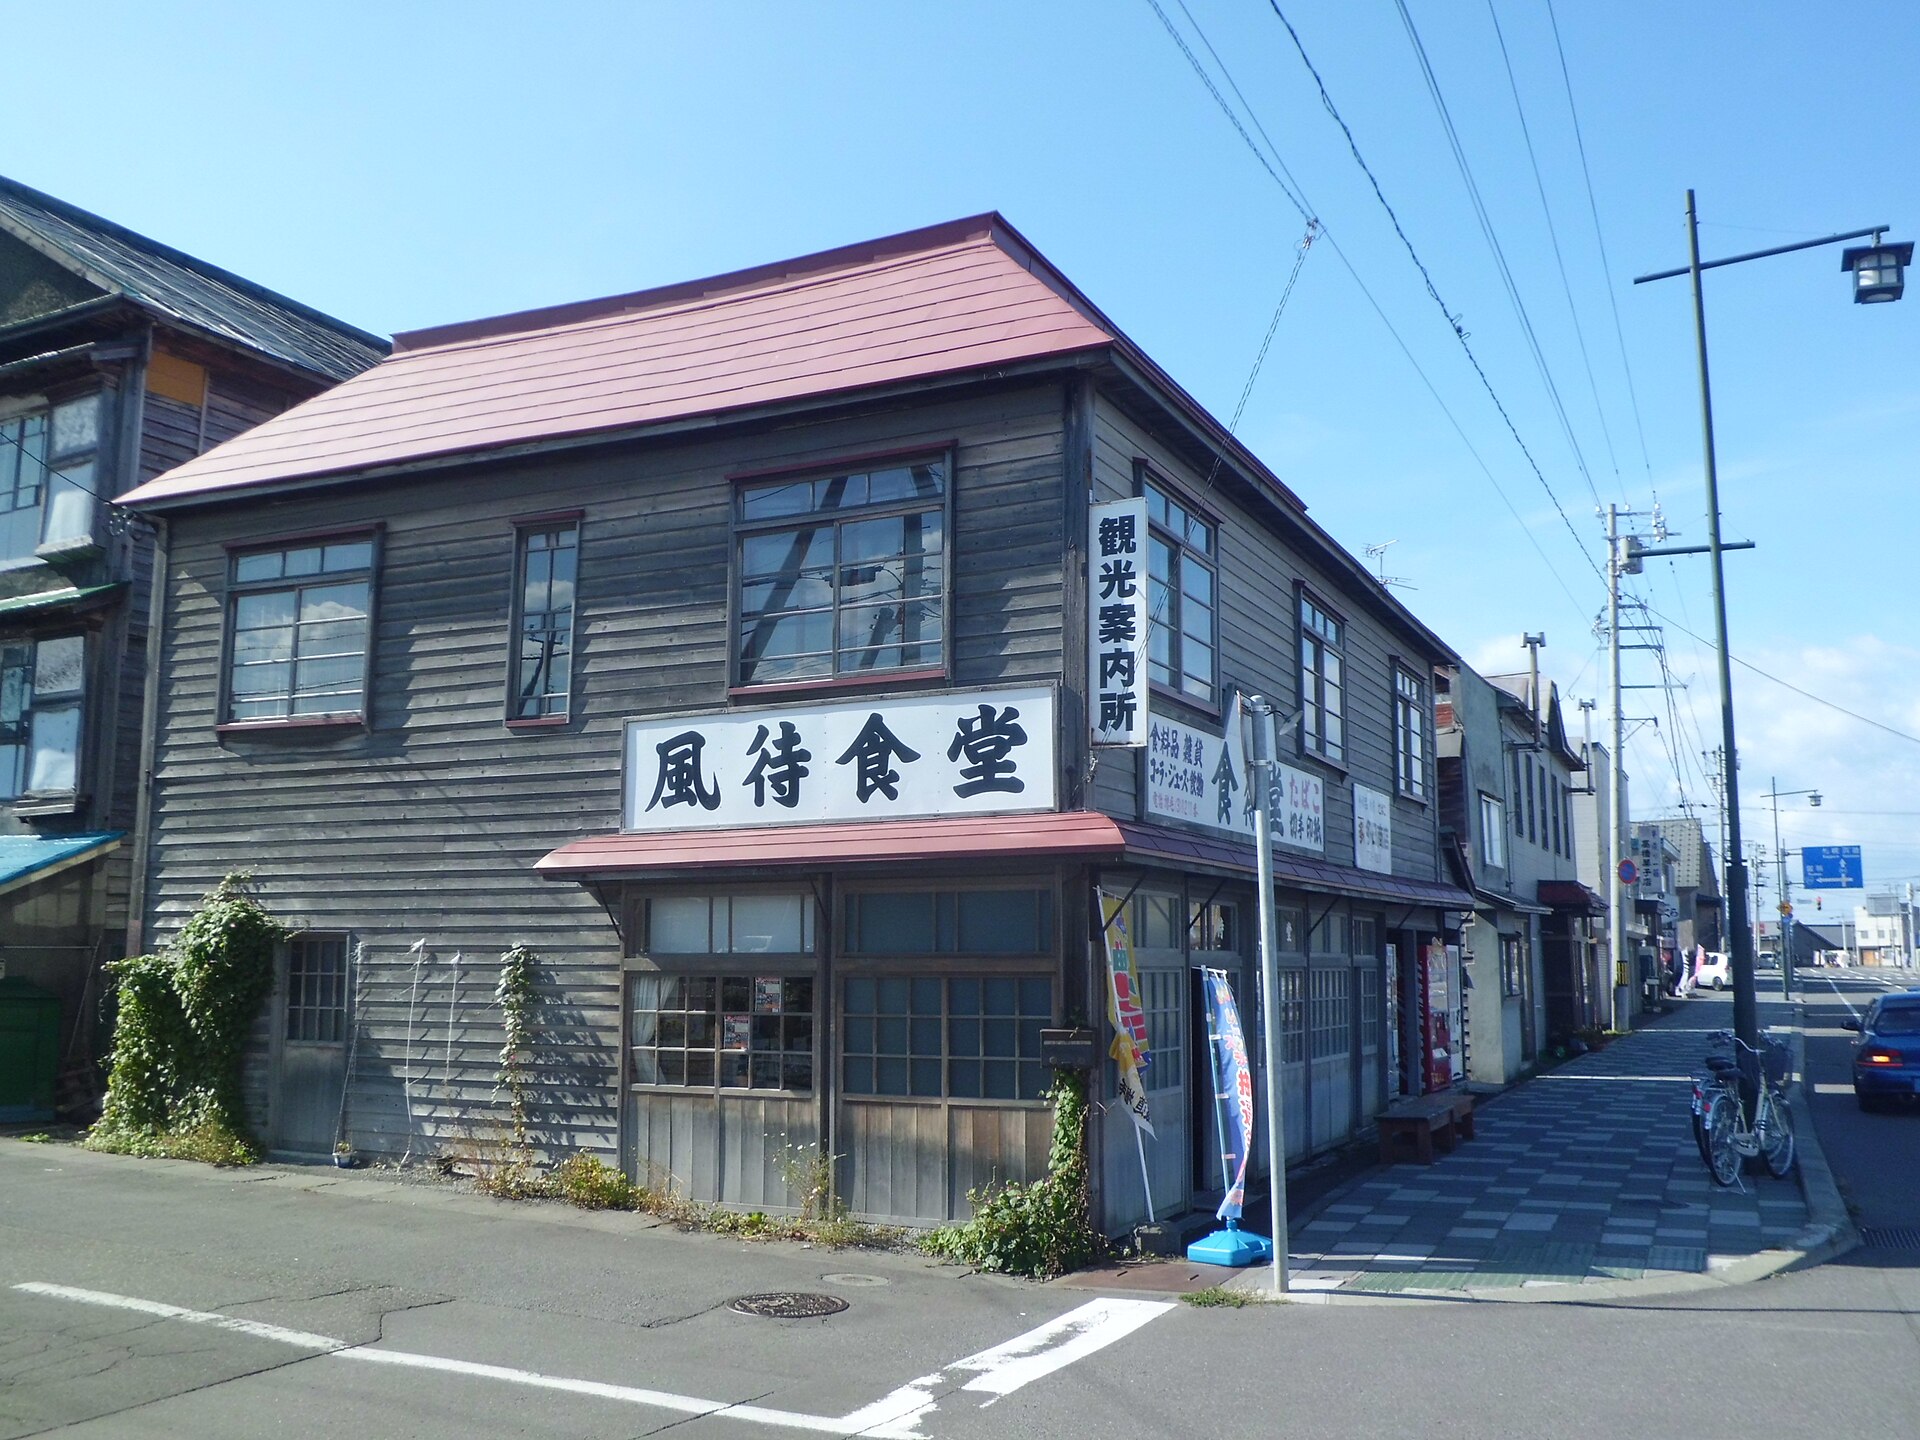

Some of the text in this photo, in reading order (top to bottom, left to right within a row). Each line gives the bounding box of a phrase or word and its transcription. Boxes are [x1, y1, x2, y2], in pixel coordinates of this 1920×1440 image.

[1099, 514, 1136, 733] 観光案内所
[645, 704, 1029, 812] 風待食堂
[1149, 722, 1180, 760] 食料品
[1289, 773, 1320, 815] たばこ
